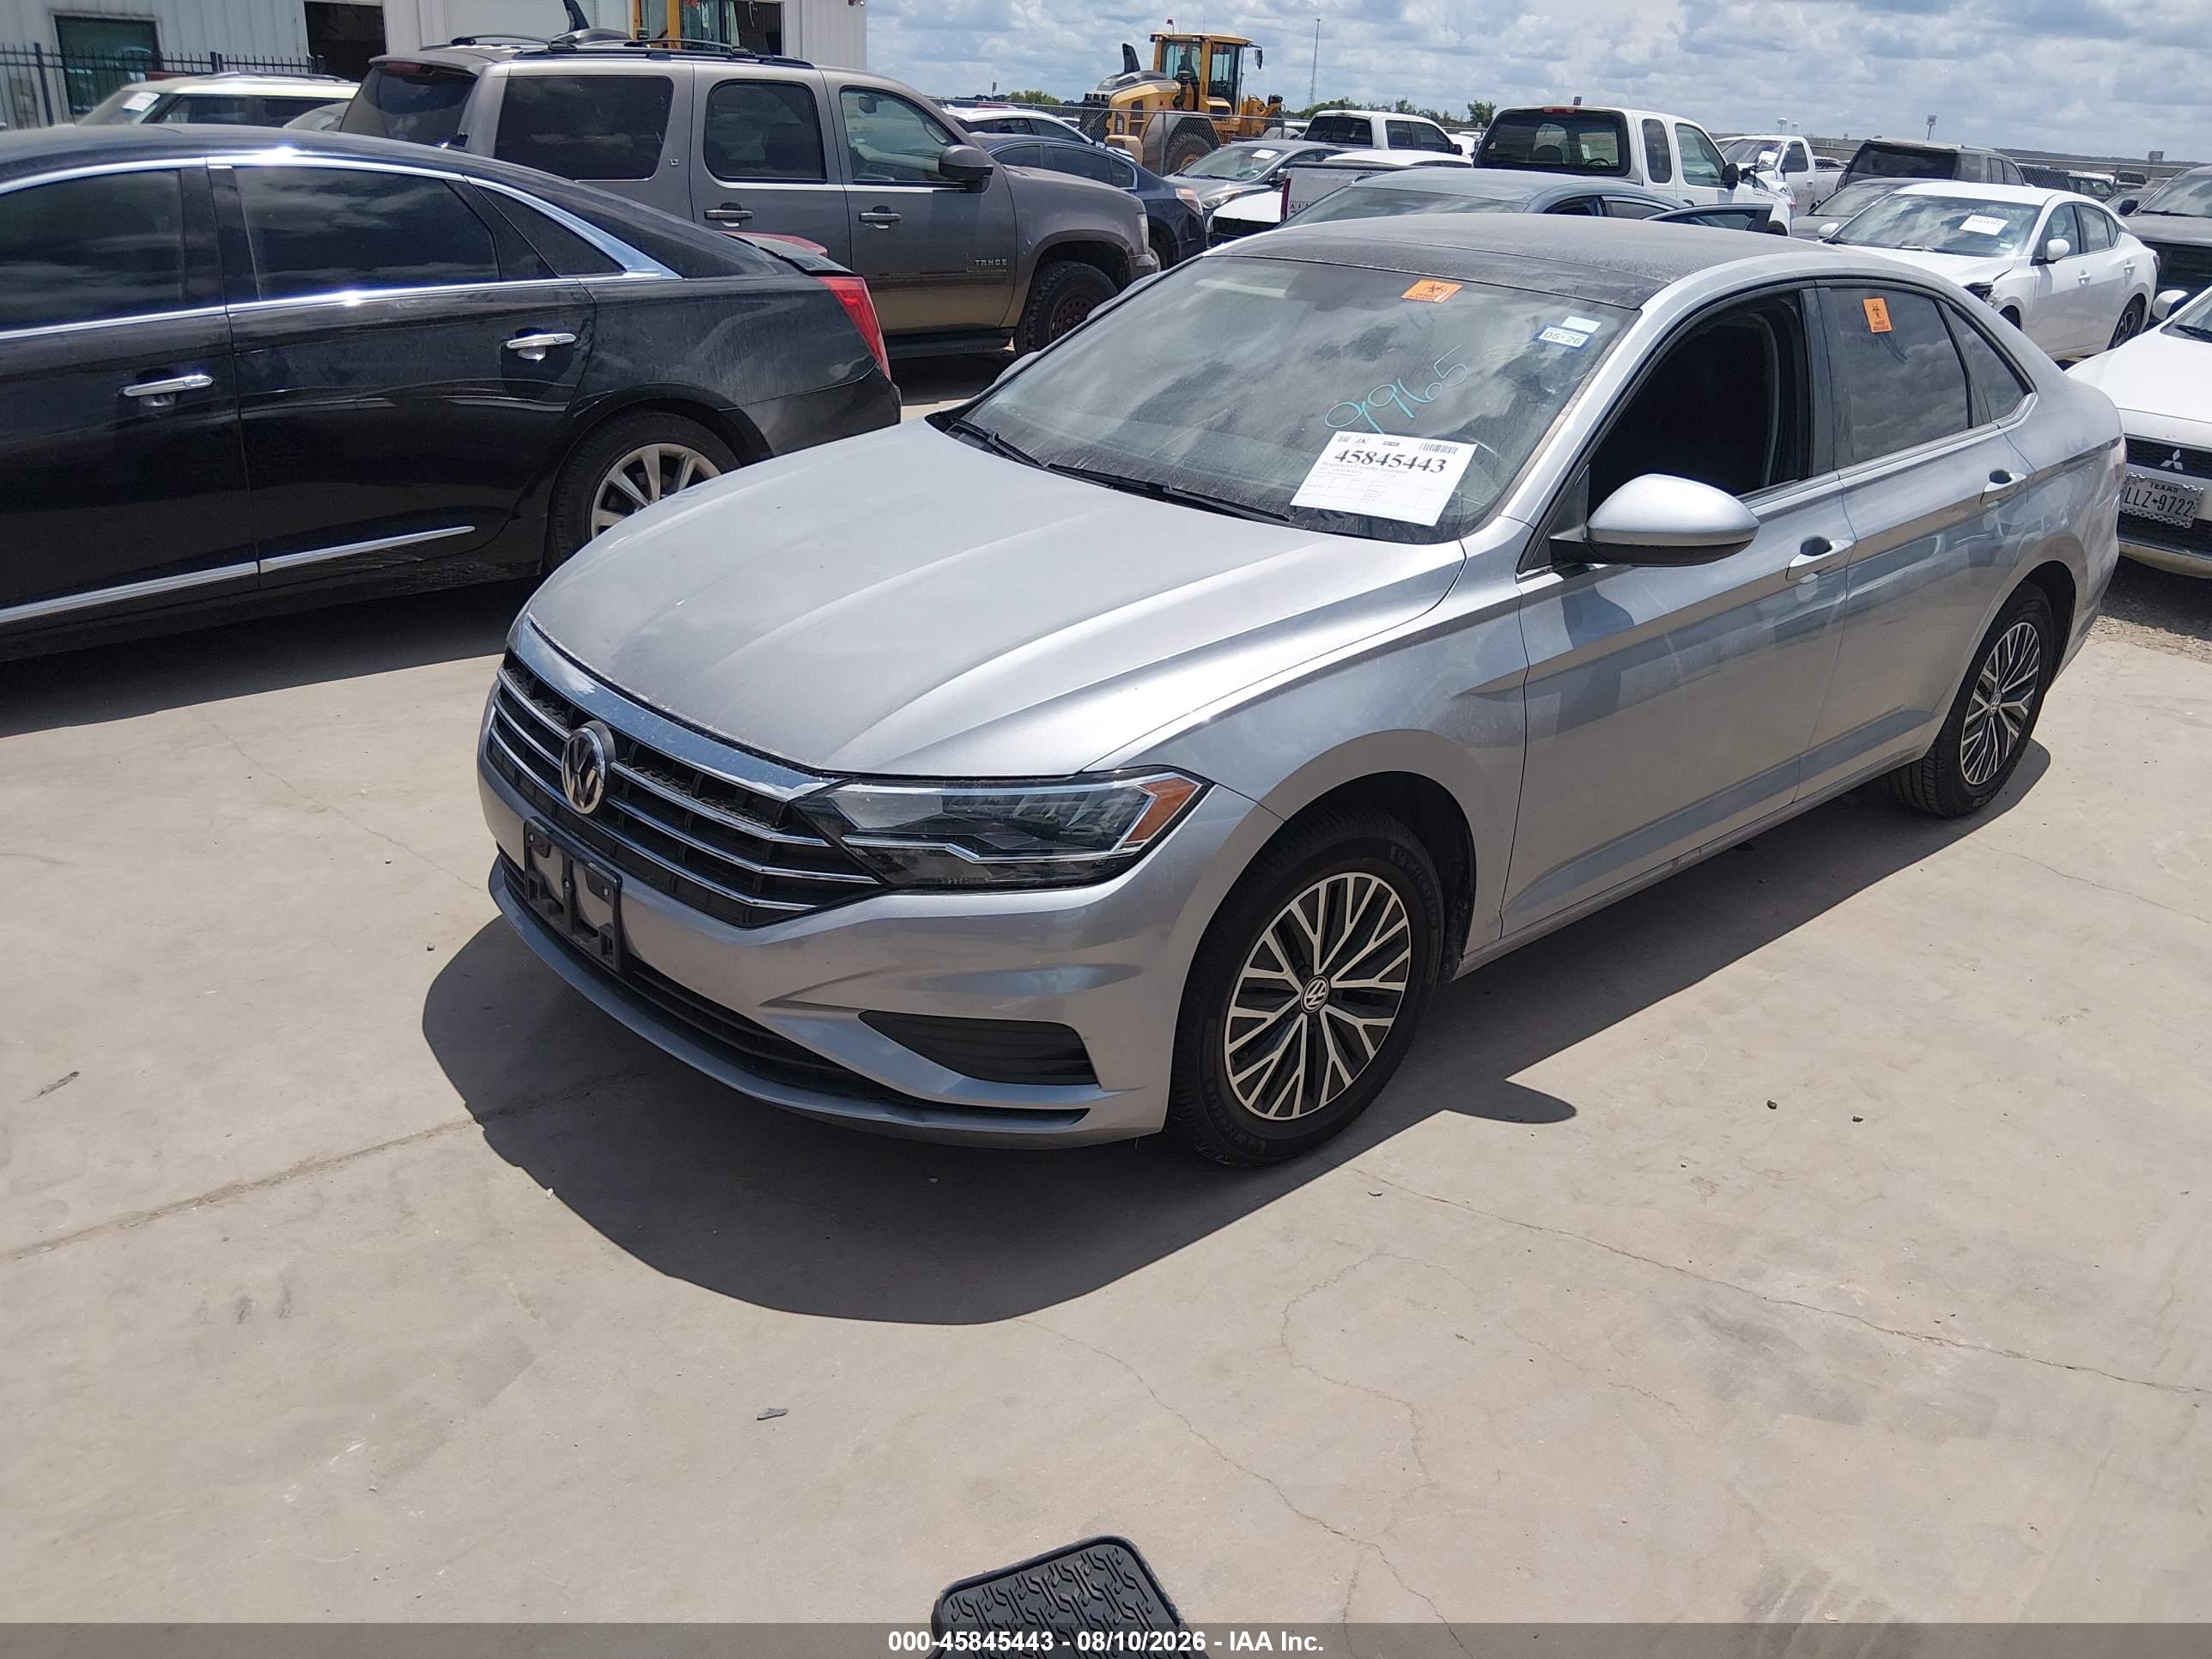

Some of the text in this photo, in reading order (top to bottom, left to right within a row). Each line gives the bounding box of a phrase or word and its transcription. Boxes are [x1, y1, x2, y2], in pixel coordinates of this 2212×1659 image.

[975, 258, 1007, 267] TAHOE
[1324, 343, 1469, 434] 9965
[1334, 449, 1448, 474] 45845443
[2149, 482, 2179, 494] TEXAS
